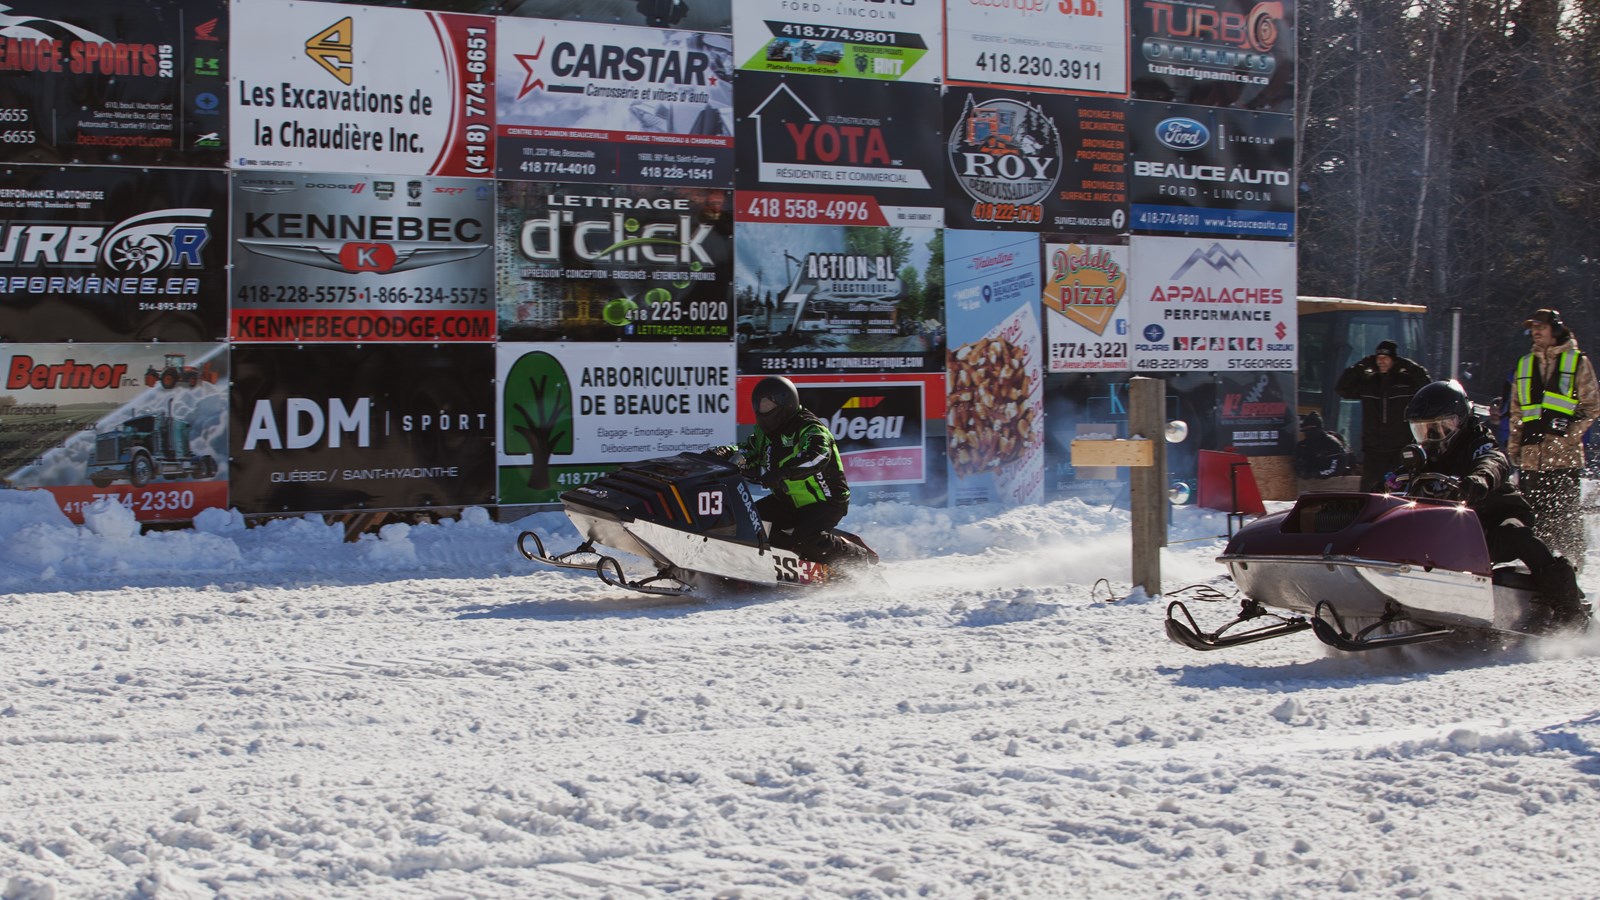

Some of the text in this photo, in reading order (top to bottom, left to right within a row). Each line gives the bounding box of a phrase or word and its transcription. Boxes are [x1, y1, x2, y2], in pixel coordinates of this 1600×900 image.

[782, 1, 896, 19] FORD LINCOLN
[782, 24, 896, 44] 418.774.9801
[70, 40, 157, 77] SPORTS
[159, 45, 173, 78] 2015
[551, 42, 709, 86] CARSTAR
[976, 52, 1101, 81] 418.230.3911
[465, 27, 488, 117] 774-6651
[1148, 63, 1269, 85] turbodynamics.ca
[239, 80, 433, 116] Les Excavations de
[586, 83, 639, 100] Carrosserie
[641, 86, 650, 99] et
[652, 87, 677, 103] vitres
[254, 119, 424, 153] la Chaudière Inc.
[507, 128, 532, 136] CENTRE
[569, 131, 609, 140] BEAUCEVILLE
[625, 134, 651, 142] GARAGE
[1165, 121, 1200, 145] Ford
[1229, 135, 1274, 145] LINCOLN
[786, 123, 891, 165] YOTA
[520, 161, 596, 175] 418 774-4010
[640, 166, 713, 180] 418 228-1541
[776, 168, 908, 184] RÉSIDENTIEL ET COMMERCIAL
[963, 152, 1053, 180] ROY
[1134, 161, 1290, 186] BEAUCE AUTO
[305, 182, 355, 190] DODGE
[432, 186, 468, 196] SRT
[1159, 185, 1271, 202] FORD LINCOLN
[547, 194, 690, 210] LETTRAGE
[748, 198, 869, 220] 418 558-4996
[244, 212, 482, 243] KENNEBEC
[1140, 212, 1199, 226] 418-774-9801
[357, 247, 380, 267] K
[808, 254, 895, 280] ACTION RL
[566, 269, 607, 278] CONCEPTION
[690, 271, 716, 281] PROMOS
[238, 286, 488, 305] 418-228-5575 1-866-234-5575
[1060, 280, 1117, 312] pizza
[1150, 285, 1284, 304] APPALACHES
[625, 301, 728, 321] 418 225-6020
[1164, 309, 1272, 321] PERFORMANCE
[238, 315, 490, 339] KENNEBECDODGE.COM
[1059, 342, 1128, 359] 774-3221
[1266, 343, 1294, 351] SUZUKI
[6, 354, 140, 390] Bertnor inc.
[766, 358, 818, 369] 225-3919
[1228, 358, 1293, 369] ST-GEORGES
[580, 366, 729, 388] ARBORICULTURE
[580, 393, 730, 415] DE BEAUCE INC
[243, 397, 487, 450] ADM SPORT
[681, 426, 714, 438] Abattage
[850, 453, 912, 467] Vitres d'autos
[271, 466, 458, 483] QUÉBEC SAINT-HYACINTHE
[556, 472, 581, 485] 418
[698, 491, 723, 515] 03
